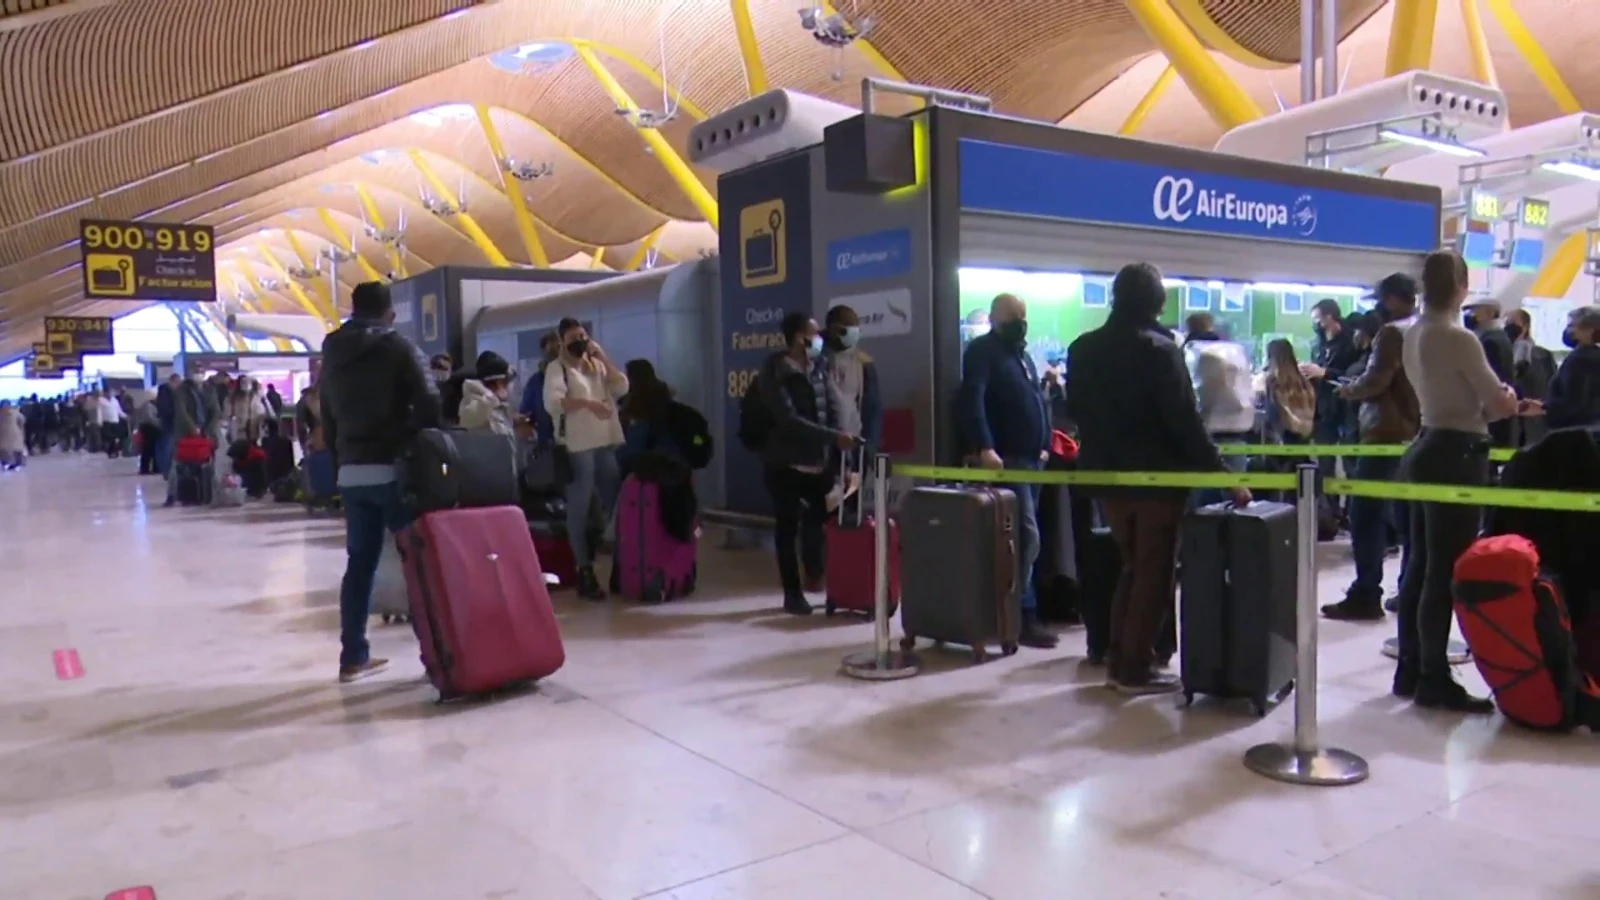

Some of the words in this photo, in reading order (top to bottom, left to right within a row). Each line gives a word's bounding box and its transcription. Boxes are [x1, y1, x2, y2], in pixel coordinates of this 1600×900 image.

[1196, 189, 1288, 230] AirEuropa
[1475, 193, 1498, 218] 881
[1524, 203, 1548, 226] 882
